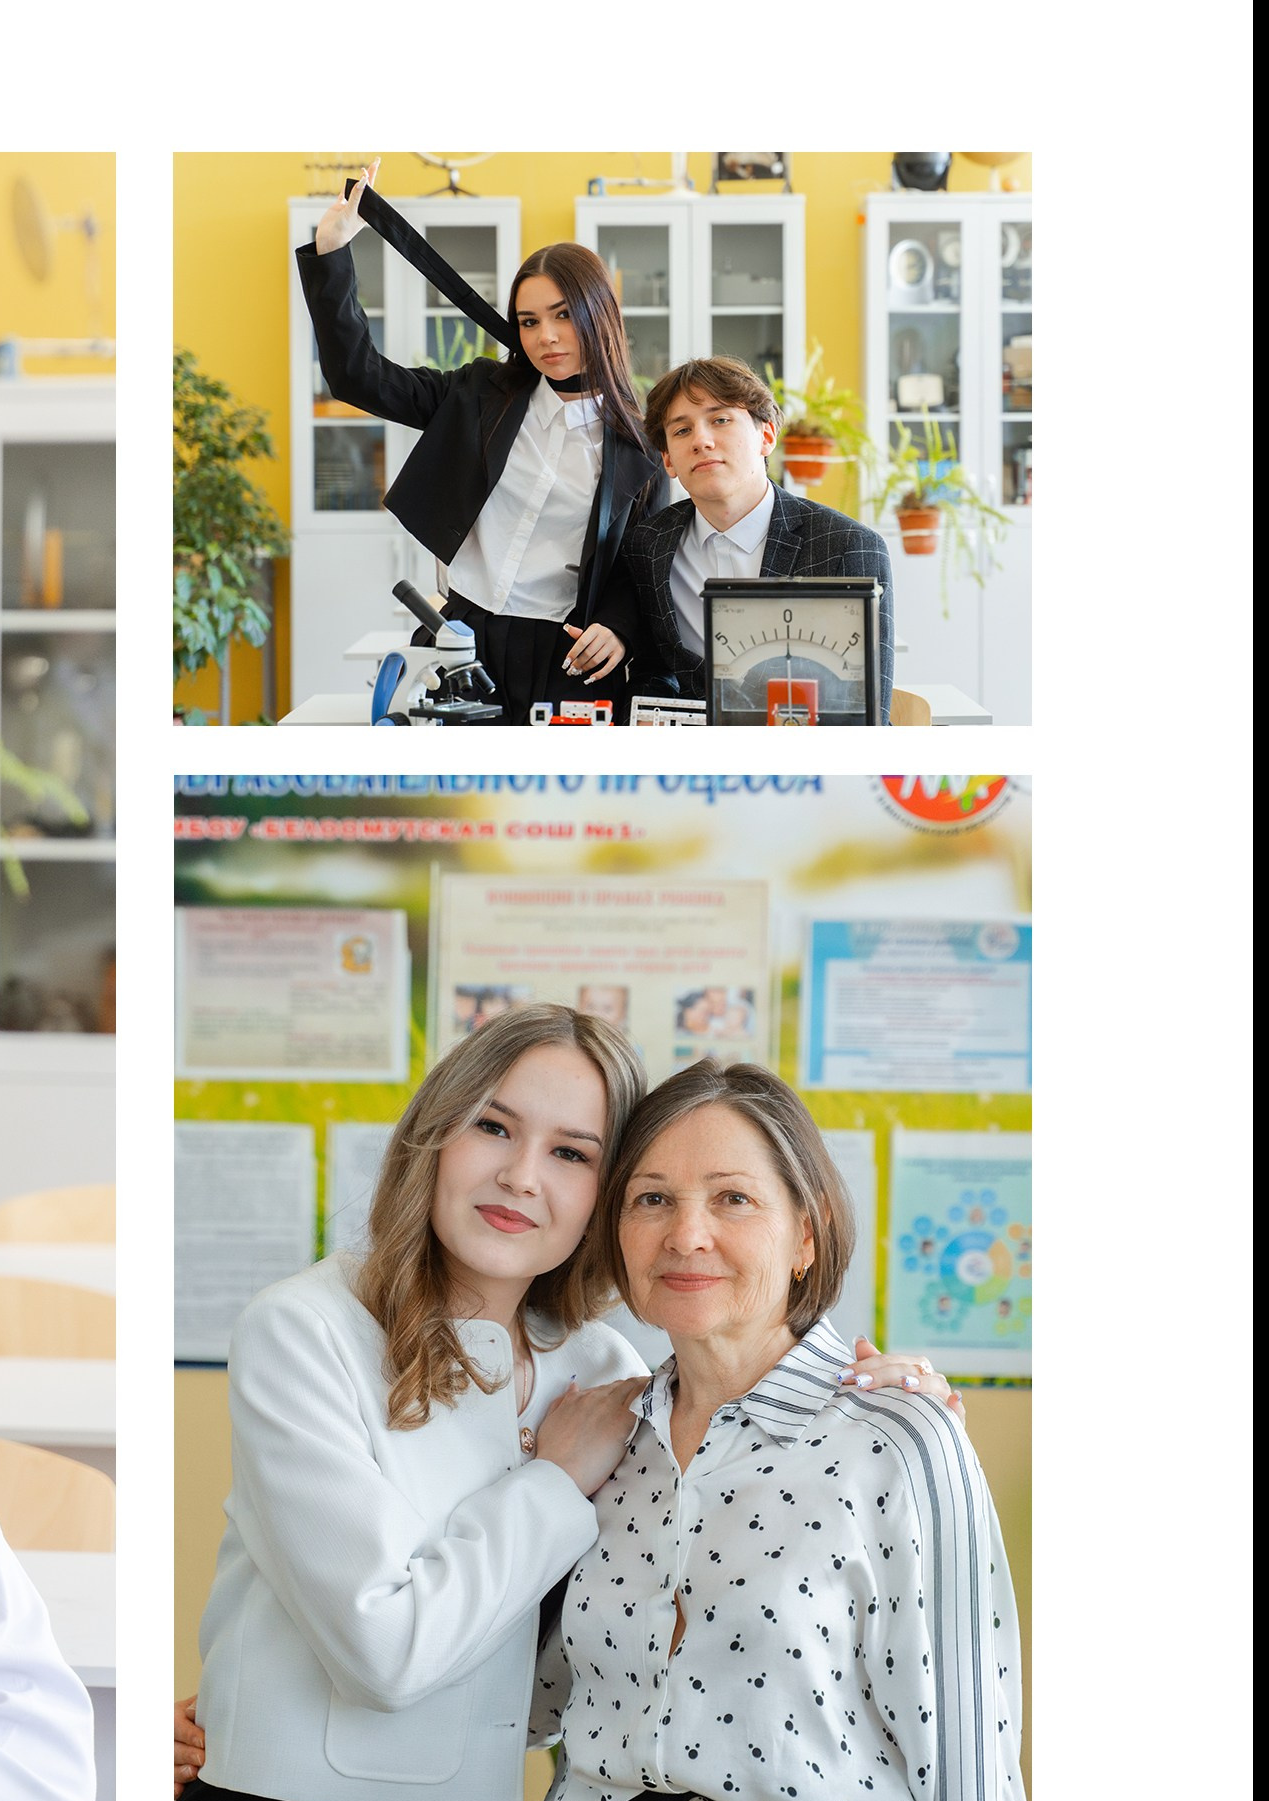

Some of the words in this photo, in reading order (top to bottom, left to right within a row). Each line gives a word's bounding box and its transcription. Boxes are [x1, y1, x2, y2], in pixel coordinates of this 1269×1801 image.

[783, 609, 793, 623] 0
[715, 632, 728, 645] 5
[848, 632, 861, 647] 5
